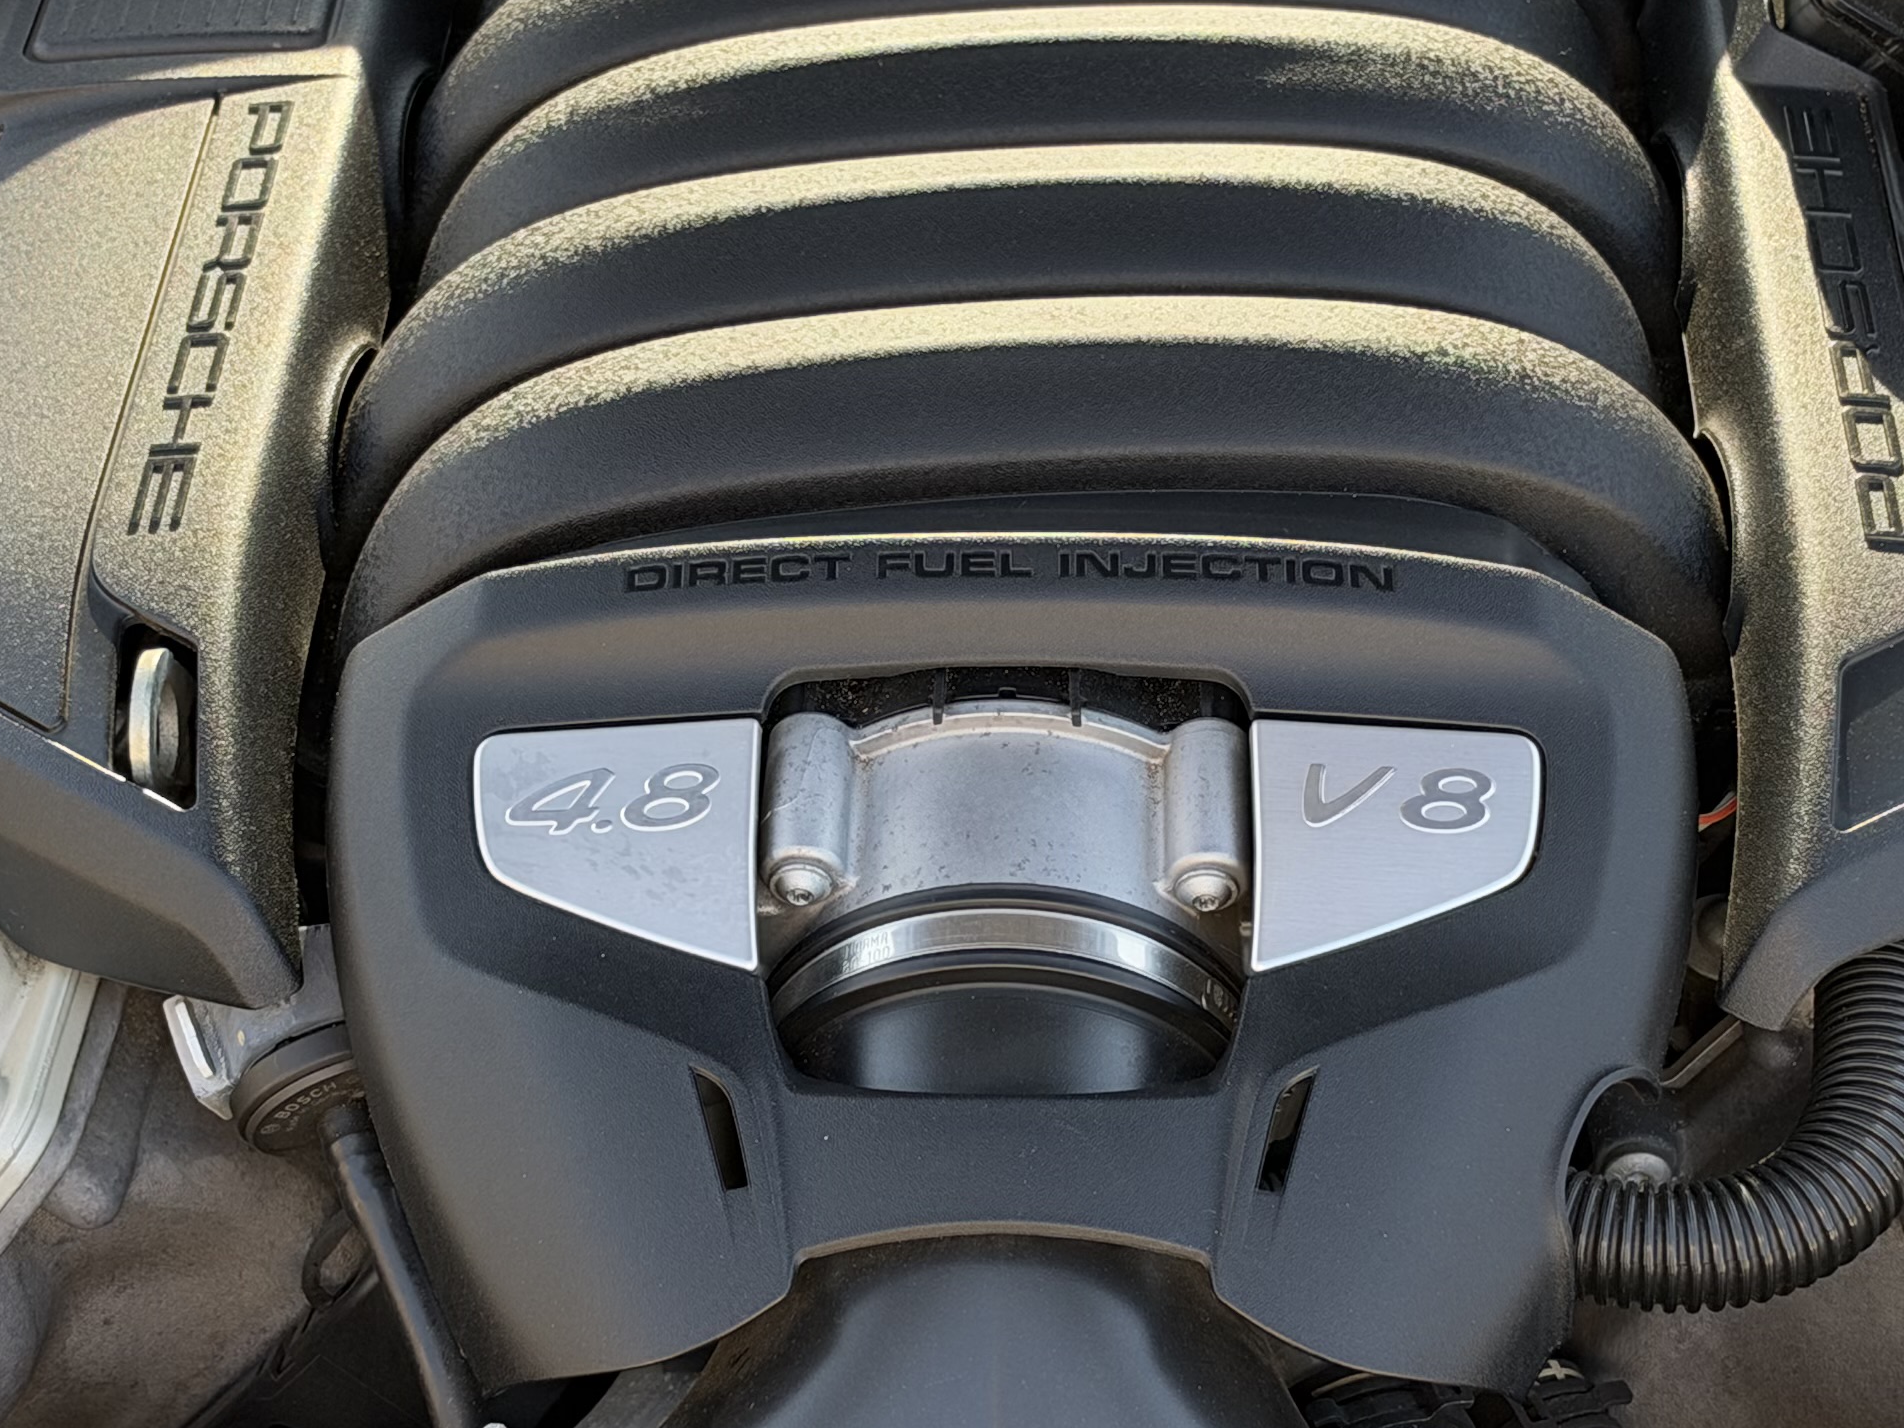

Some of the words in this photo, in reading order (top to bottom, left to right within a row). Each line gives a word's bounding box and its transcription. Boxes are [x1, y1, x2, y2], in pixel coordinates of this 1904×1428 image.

[128, 100, 295, 535] PORSCHE
[624, 551, 854, 595] DIRECT
[876, 549, 1035, 580] FUEL
[1056, 549, 1396, 593] INJECTION
[505, 763, 721, 835] 4.8
[274, 1081, 337, 1119] BOSCH
